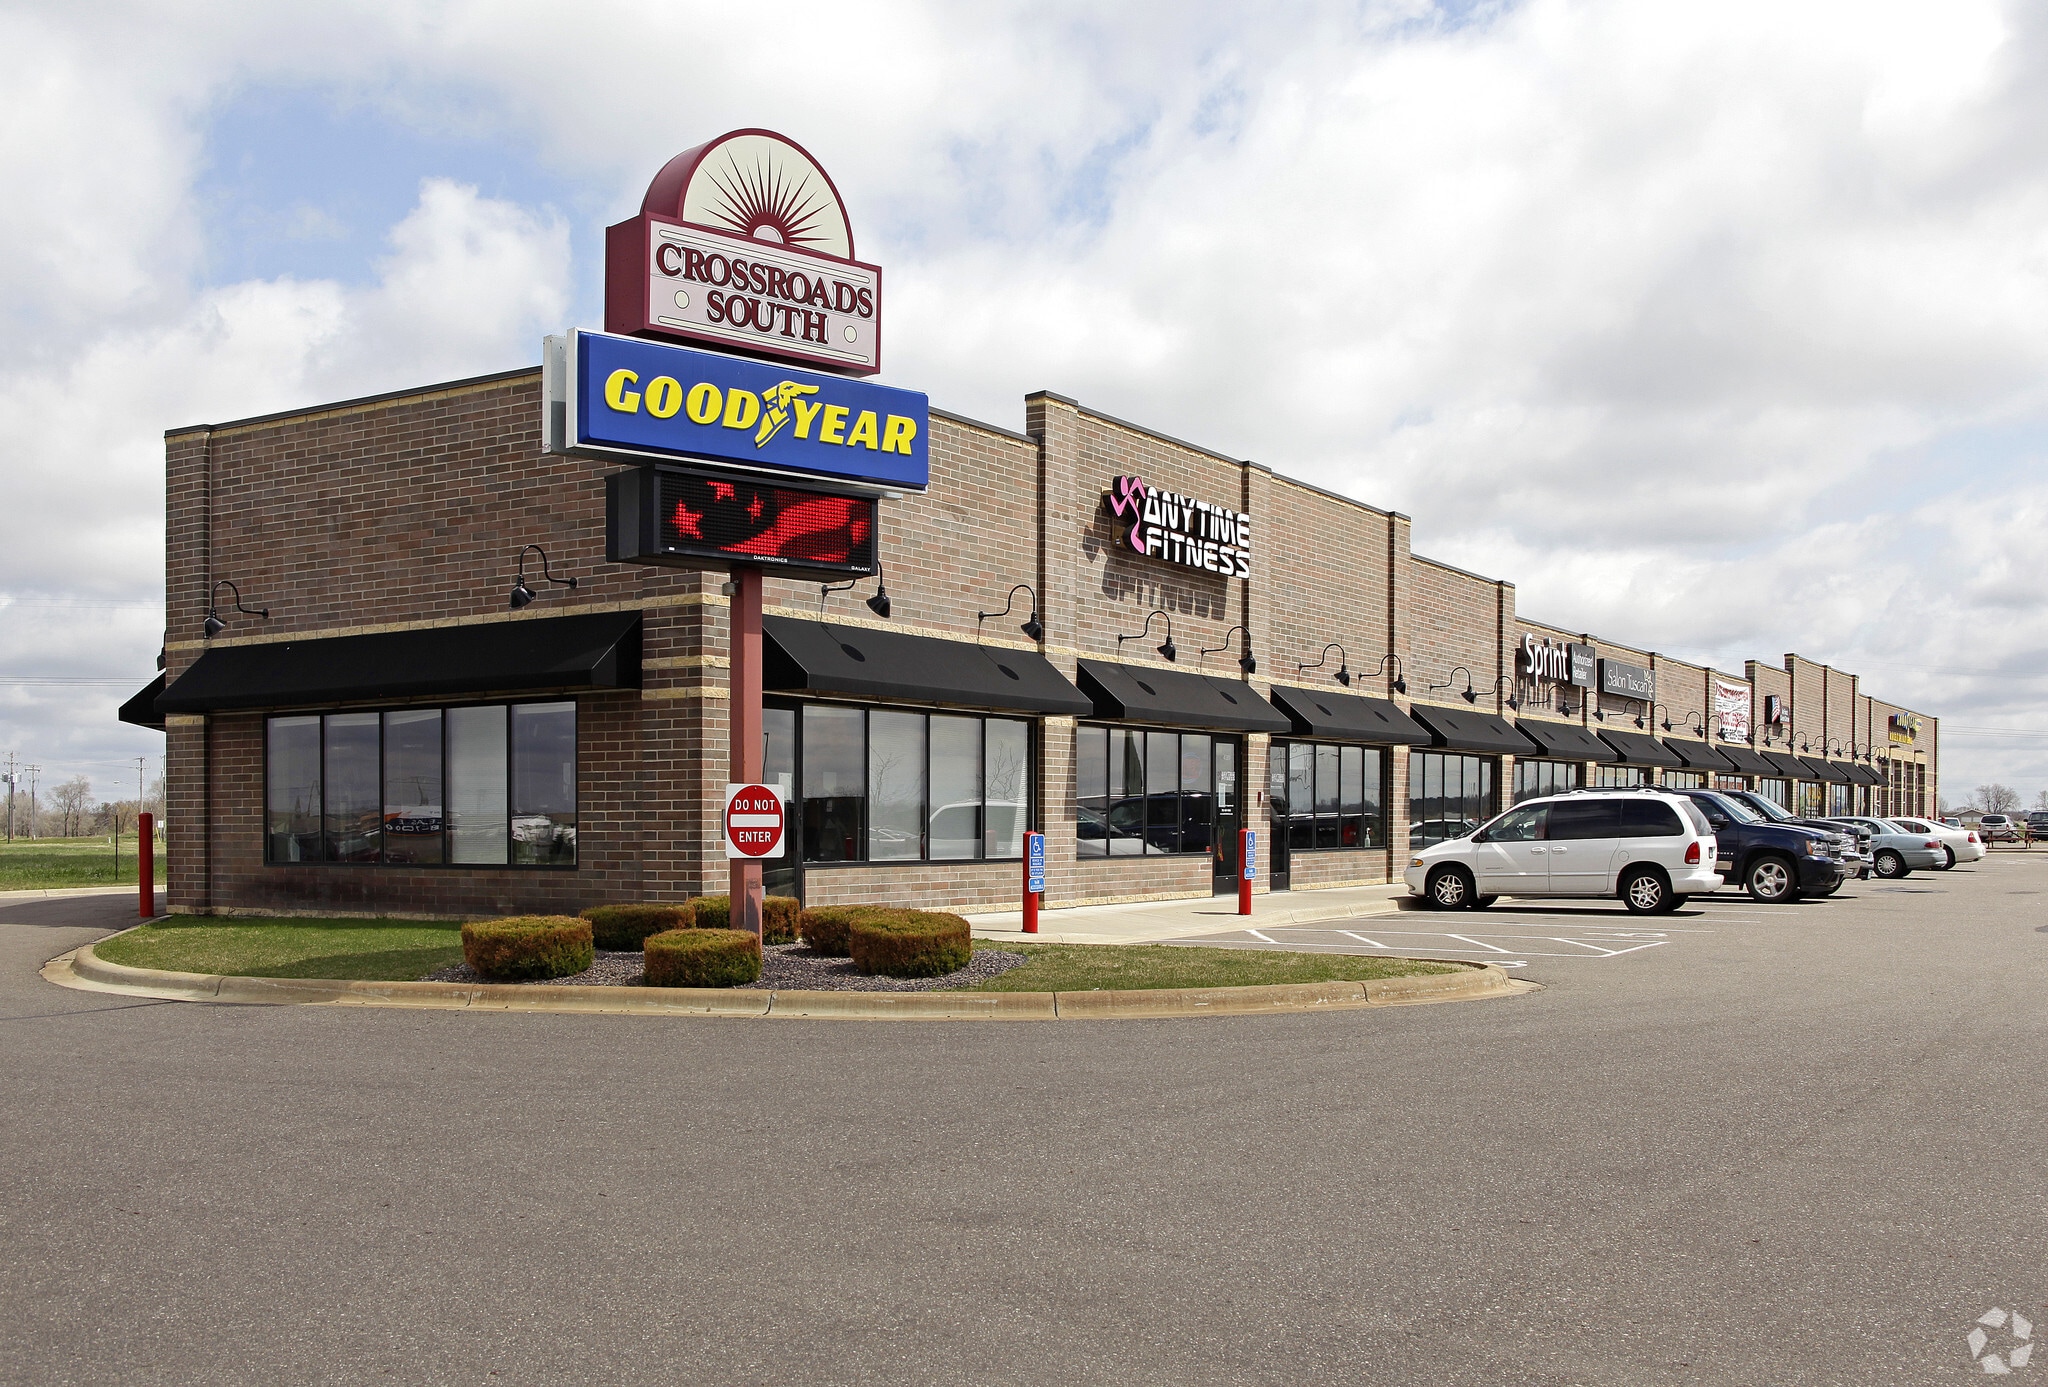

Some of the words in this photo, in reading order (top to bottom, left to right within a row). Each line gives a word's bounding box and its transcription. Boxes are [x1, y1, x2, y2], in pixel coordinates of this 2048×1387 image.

[656, 243, 873, 318] CROSSROADS
[707, 290, 828, 344] SOUTH
[1143, 486, 1250, 549] ANYTIME
[753, 554, 788, 563] DAKTRONICS
[1146, 526, 1250, 579] FITNESS
[1525, 632, 1568, 687] Sprint
[1607, 664, 1626, 689] Salon
[735, 799, 750, 811] DO
[754, 799, 776, 811] NOT
[738, 831, 772, 843] ENTER
